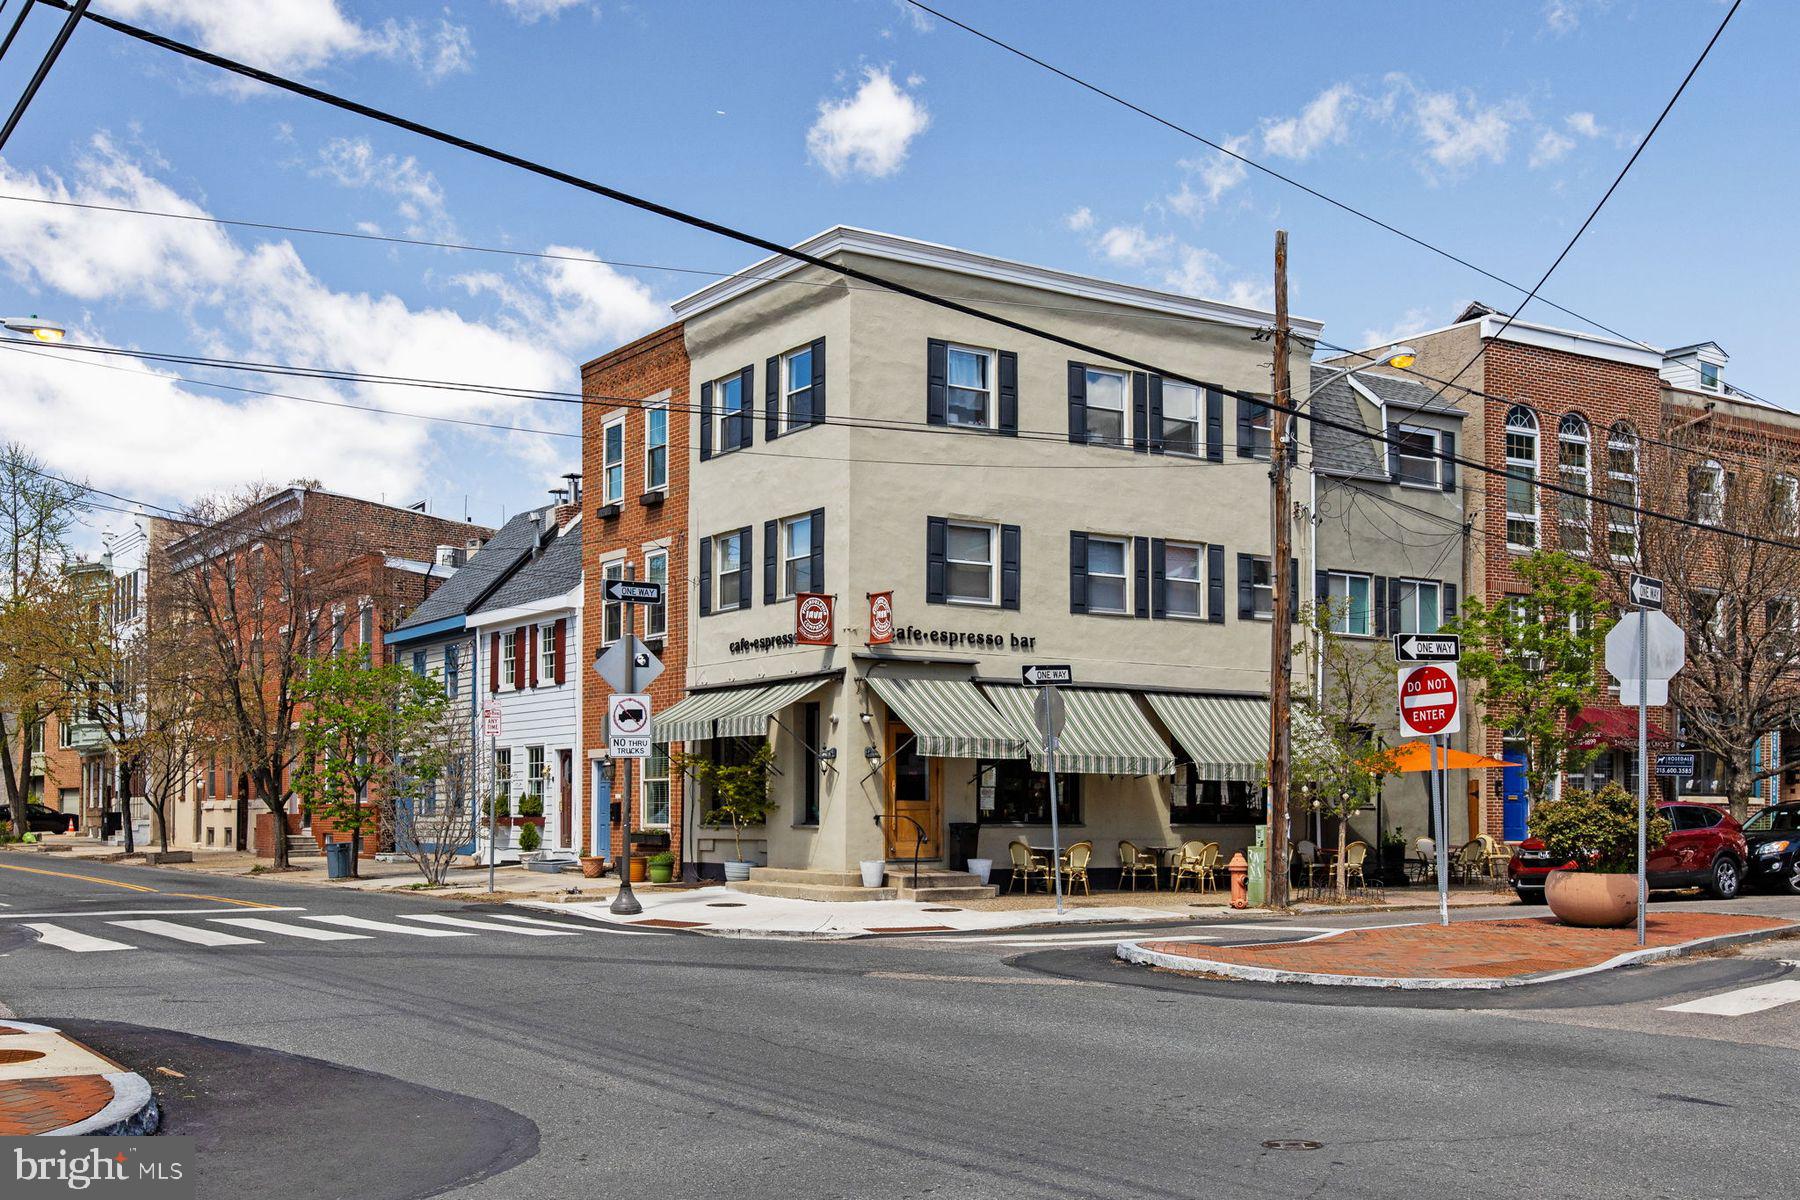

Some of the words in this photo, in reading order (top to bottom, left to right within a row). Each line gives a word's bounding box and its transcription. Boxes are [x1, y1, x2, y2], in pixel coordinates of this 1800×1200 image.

[621, 586, 637, 596] ONE
[638, 588, 655, 597] WAY
[1640, 585, 1649, 598] ONE
[805, 610, 823, 619] JAVA
[1010, 632, 1036, 648] bar
[1416, 642, 1434, 653] ONE
[1435, 642, 1453, 653] WAY
[1036, 670, 1051, 679] ONE
[1052, 670, 1067, 679] WAY
[1407, 681, 1422, 693] DO
[1427, 678, 1448, 691] NOT
[1412, 709, 1446, 722] ENTER
[613, 738, 626, 747] NO
[617, 747, 645, 755] TRUCKS
